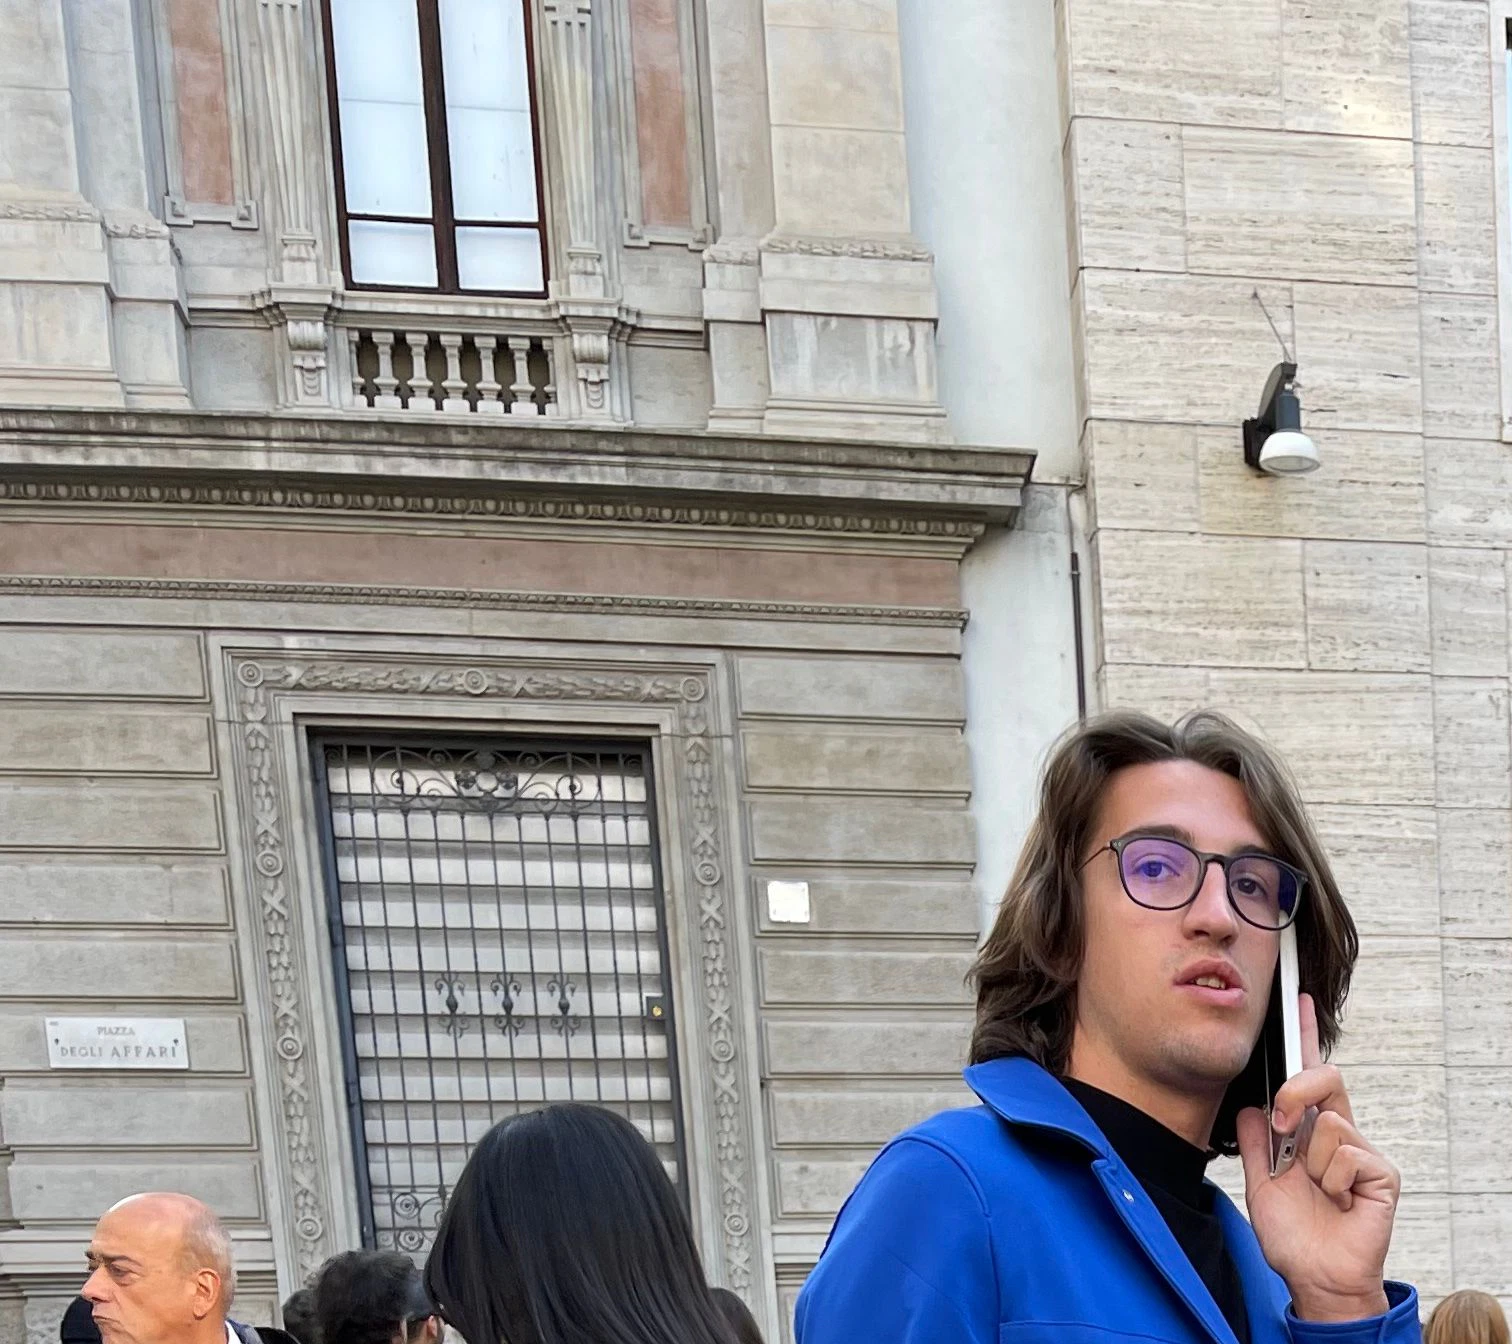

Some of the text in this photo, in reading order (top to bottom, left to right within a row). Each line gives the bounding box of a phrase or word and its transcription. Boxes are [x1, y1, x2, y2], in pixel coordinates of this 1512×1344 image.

[97, 1026, 136, 1036] PIAZZA
[60, 1046, 177, 1058] DEGLI AFFARI
